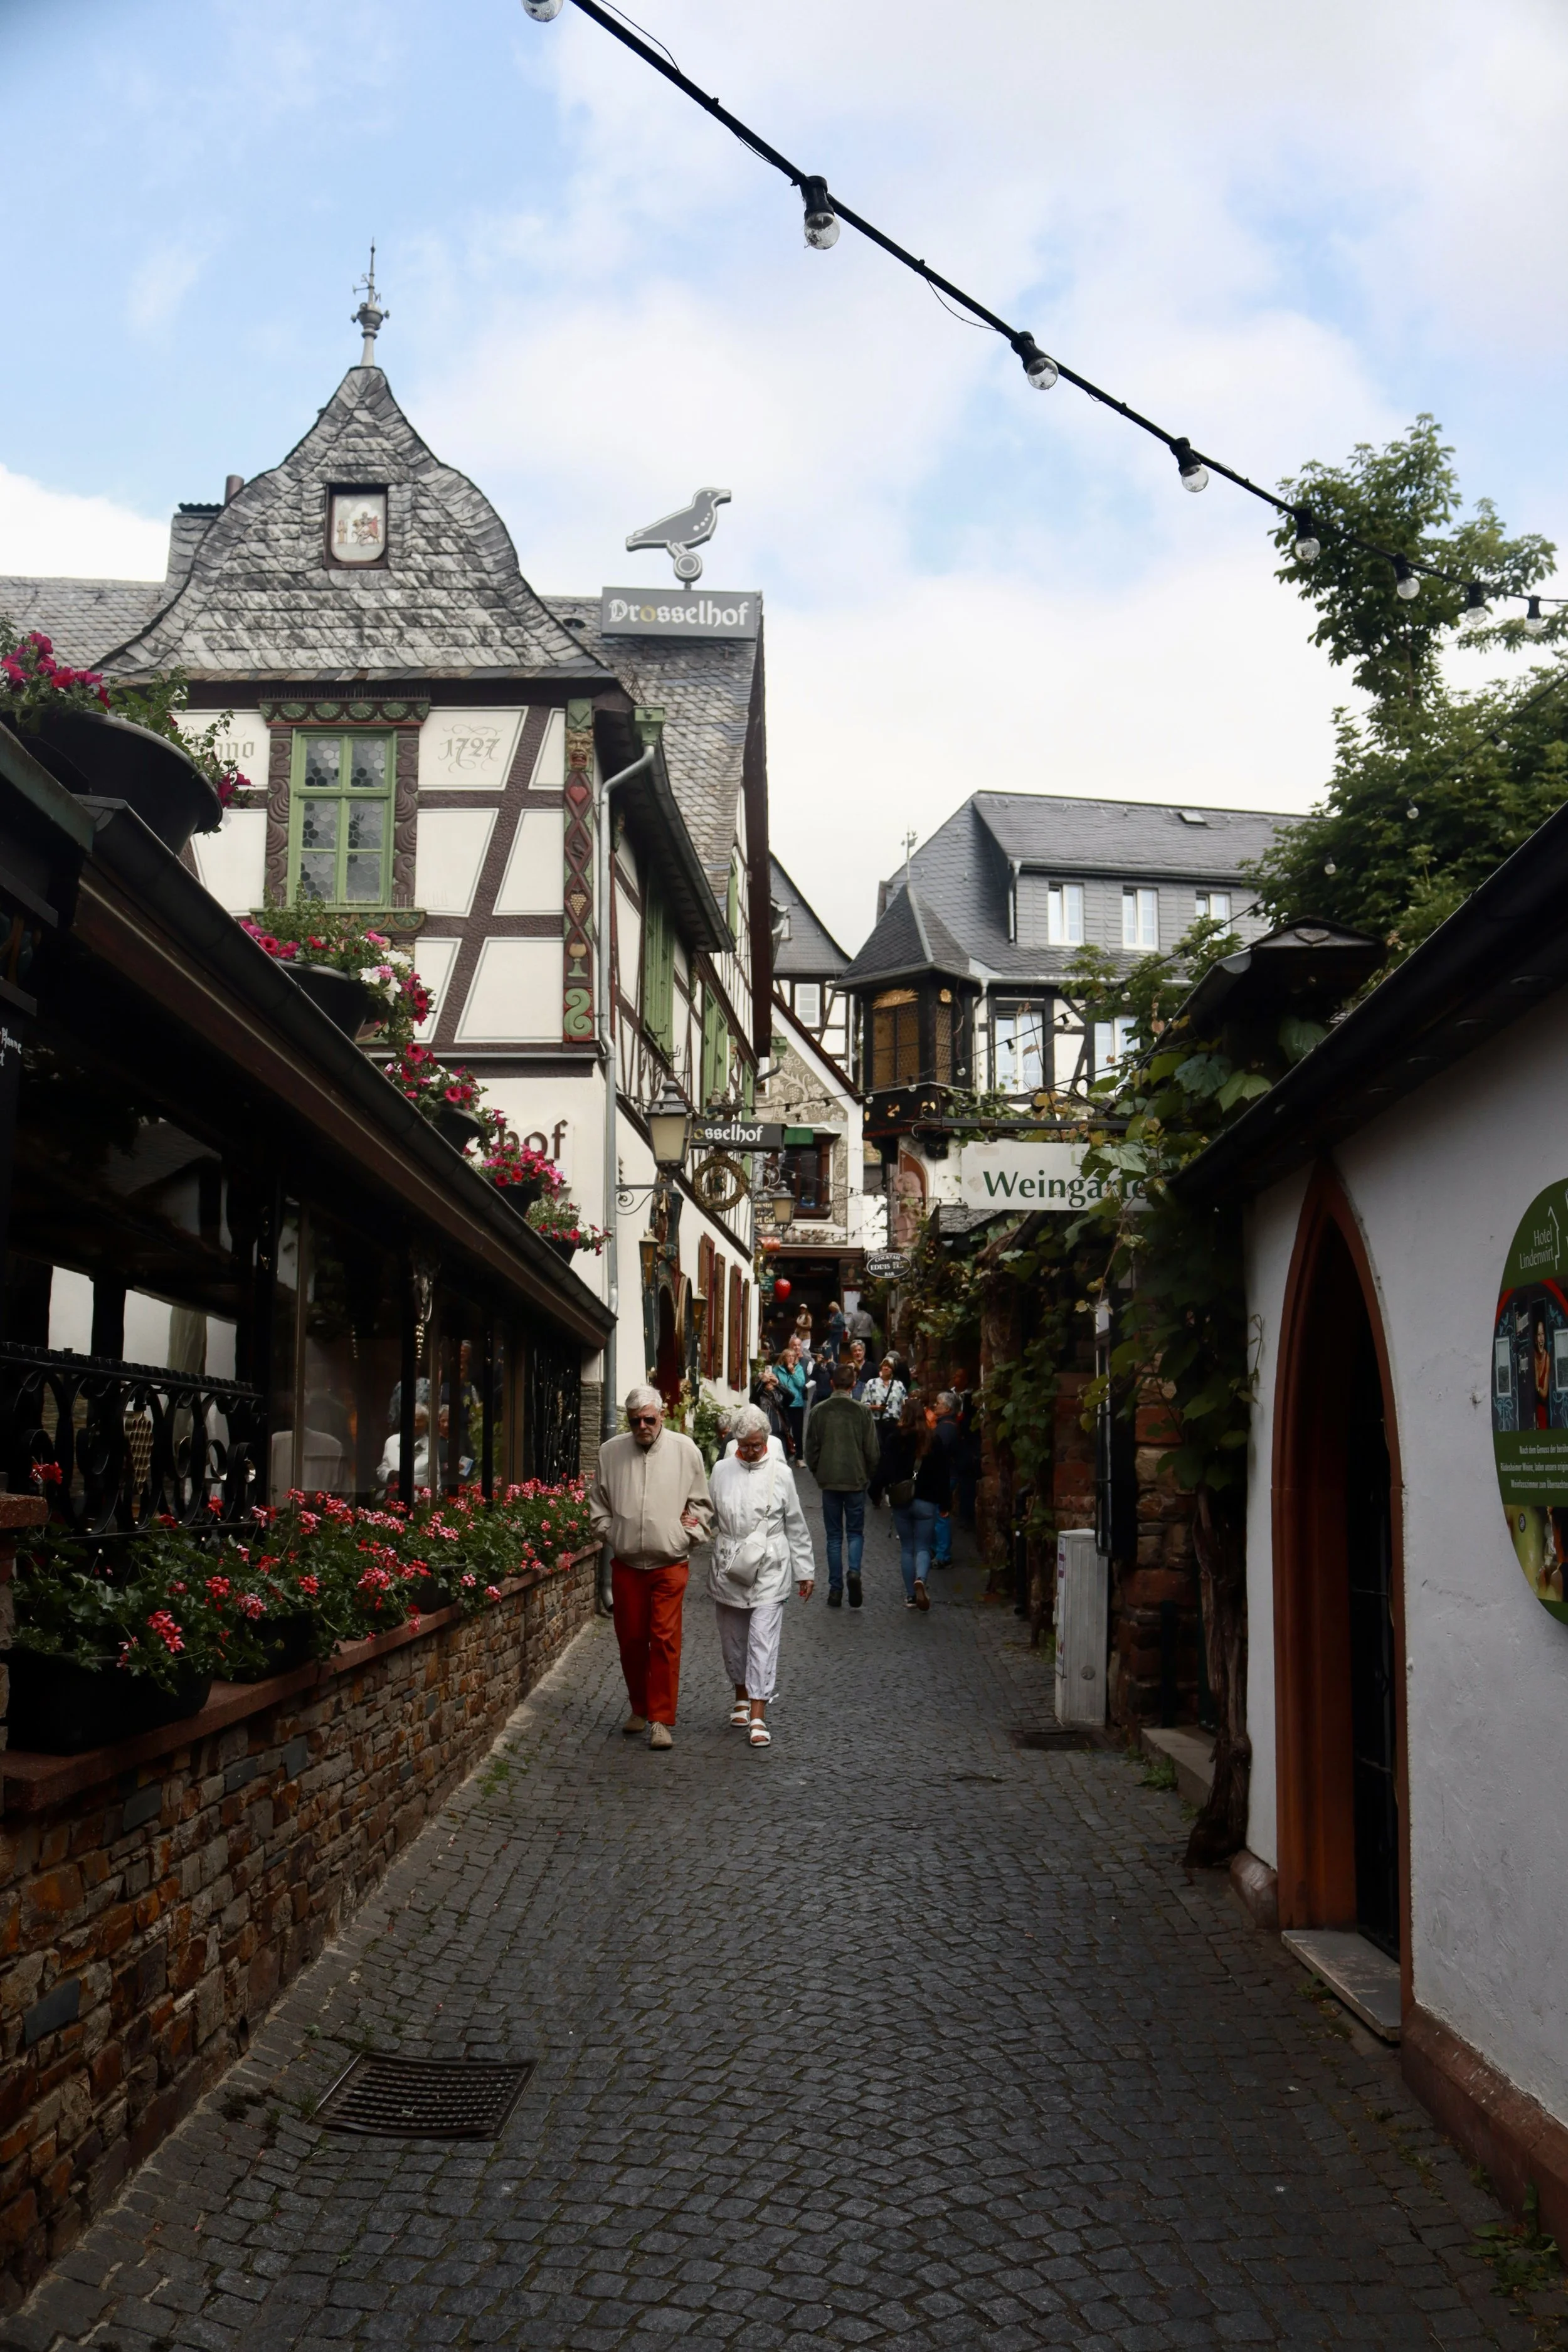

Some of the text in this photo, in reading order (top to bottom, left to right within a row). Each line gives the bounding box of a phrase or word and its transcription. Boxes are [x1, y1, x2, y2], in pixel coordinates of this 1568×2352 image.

[608, 599, 750, 627] Drosselhof
[438, 737, 501, 768] 1727
[692, 1124, 763, 1143] osselhof
[983, 1169, 1147, 1208] Weingarte
[1534, 1224, 1552, 1247] Hotel
[874, 1254, 901, 1263] COCKTAIL
[1519, 1245, 1554, 1269] Lindenwirt
[1519, 1445, 1528, 1454] Nach
[1537, 1444, 1549, 1454] Genuss
